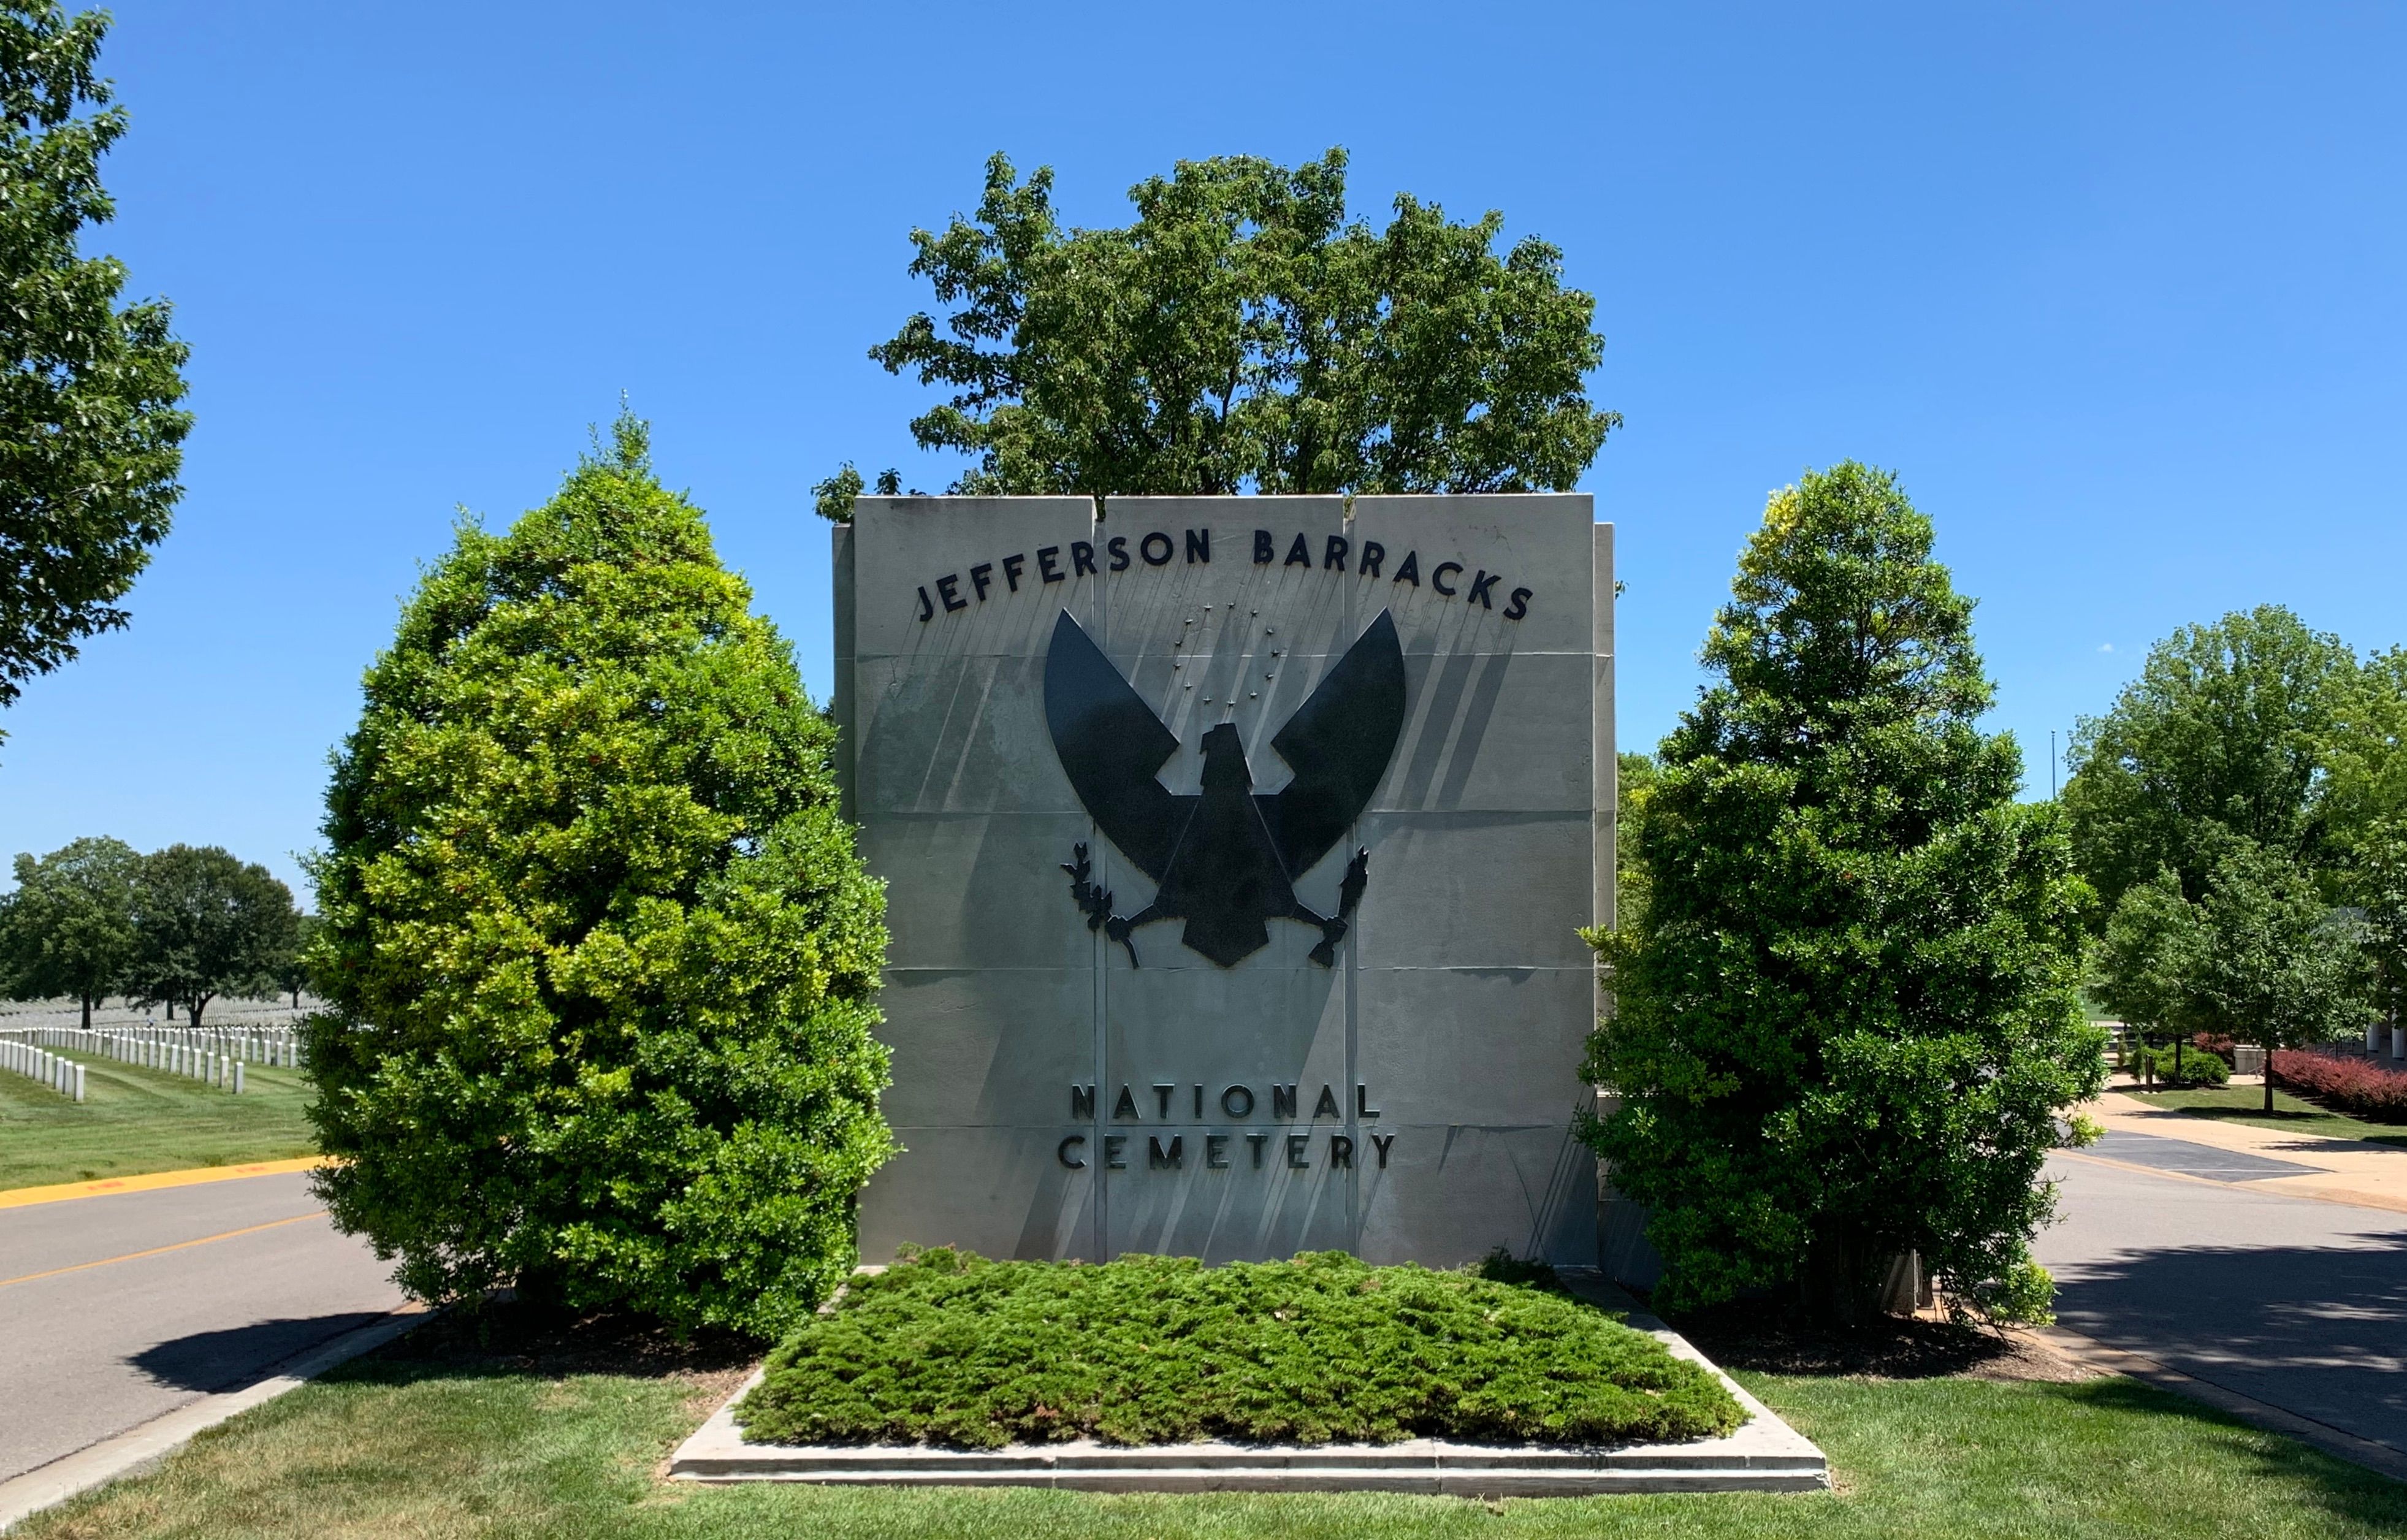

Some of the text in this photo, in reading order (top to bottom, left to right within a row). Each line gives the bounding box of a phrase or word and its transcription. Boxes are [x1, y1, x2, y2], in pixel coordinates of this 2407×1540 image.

[917, 528, 1533, 622] JEFFERSON BARRACKS
[1072, 1083, 1381, 1119] NATIONAL
[1058, 1134, 1395, 1169] CEMETERY
